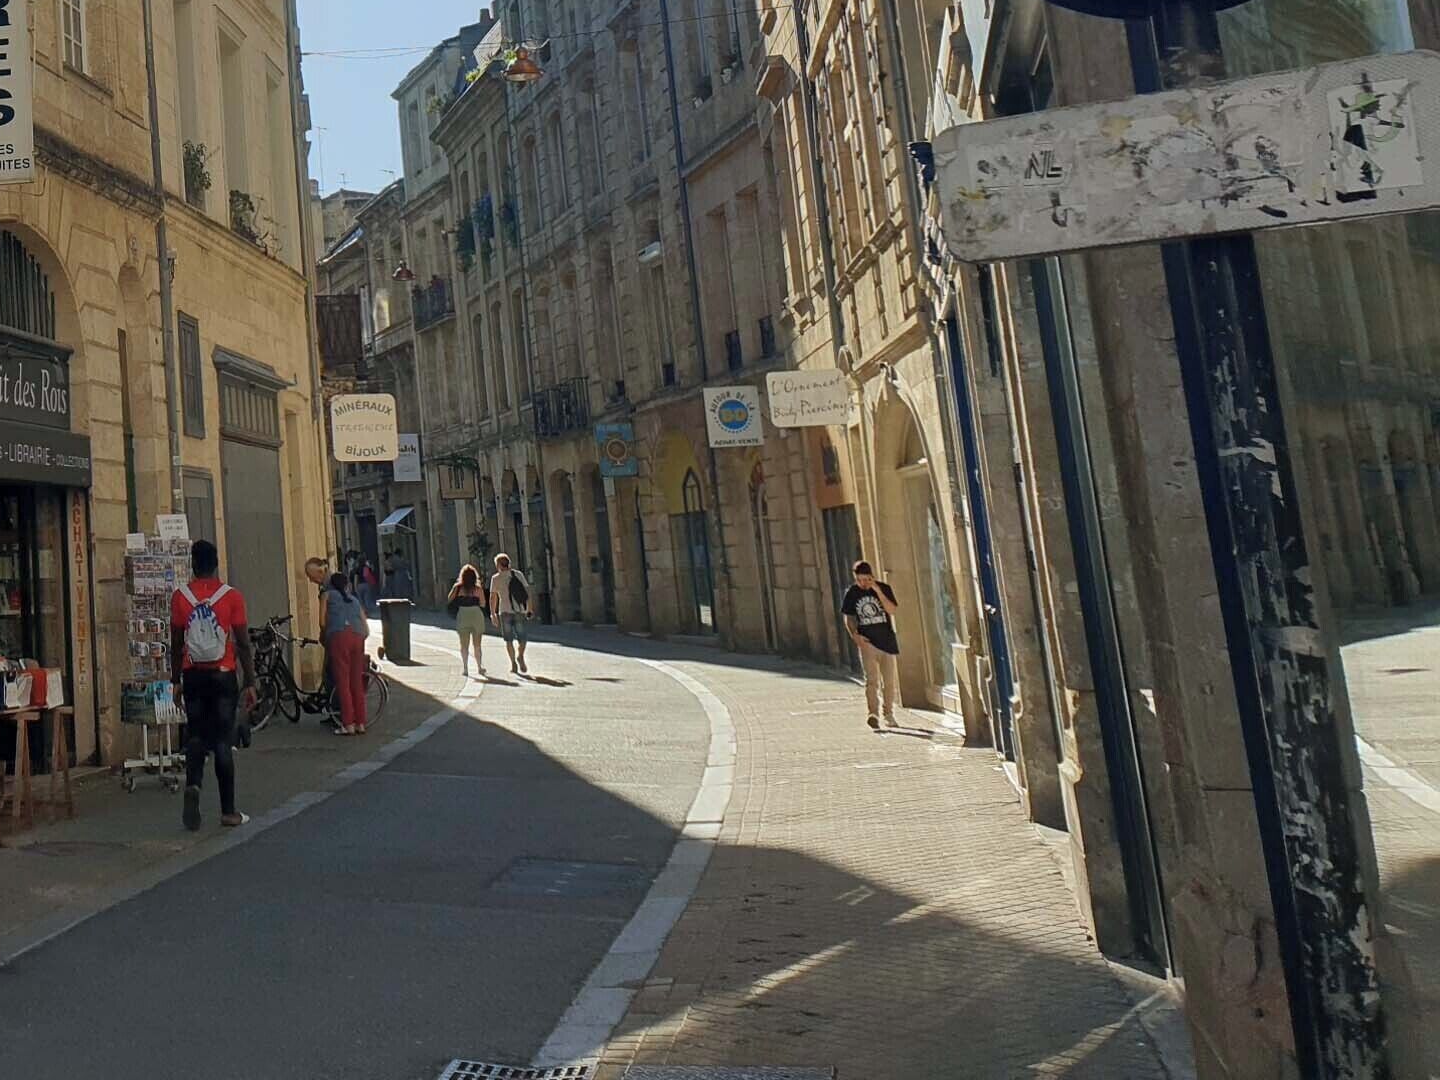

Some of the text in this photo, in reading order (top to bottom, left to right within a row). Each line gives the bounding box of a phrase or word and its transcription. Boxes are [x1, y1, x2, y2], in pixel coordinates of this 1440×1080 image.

[13, 362, 36, 409] des
[41, 369, 67, 415] Rois
[9, 443, 51, 467] LIBRAIRIE
